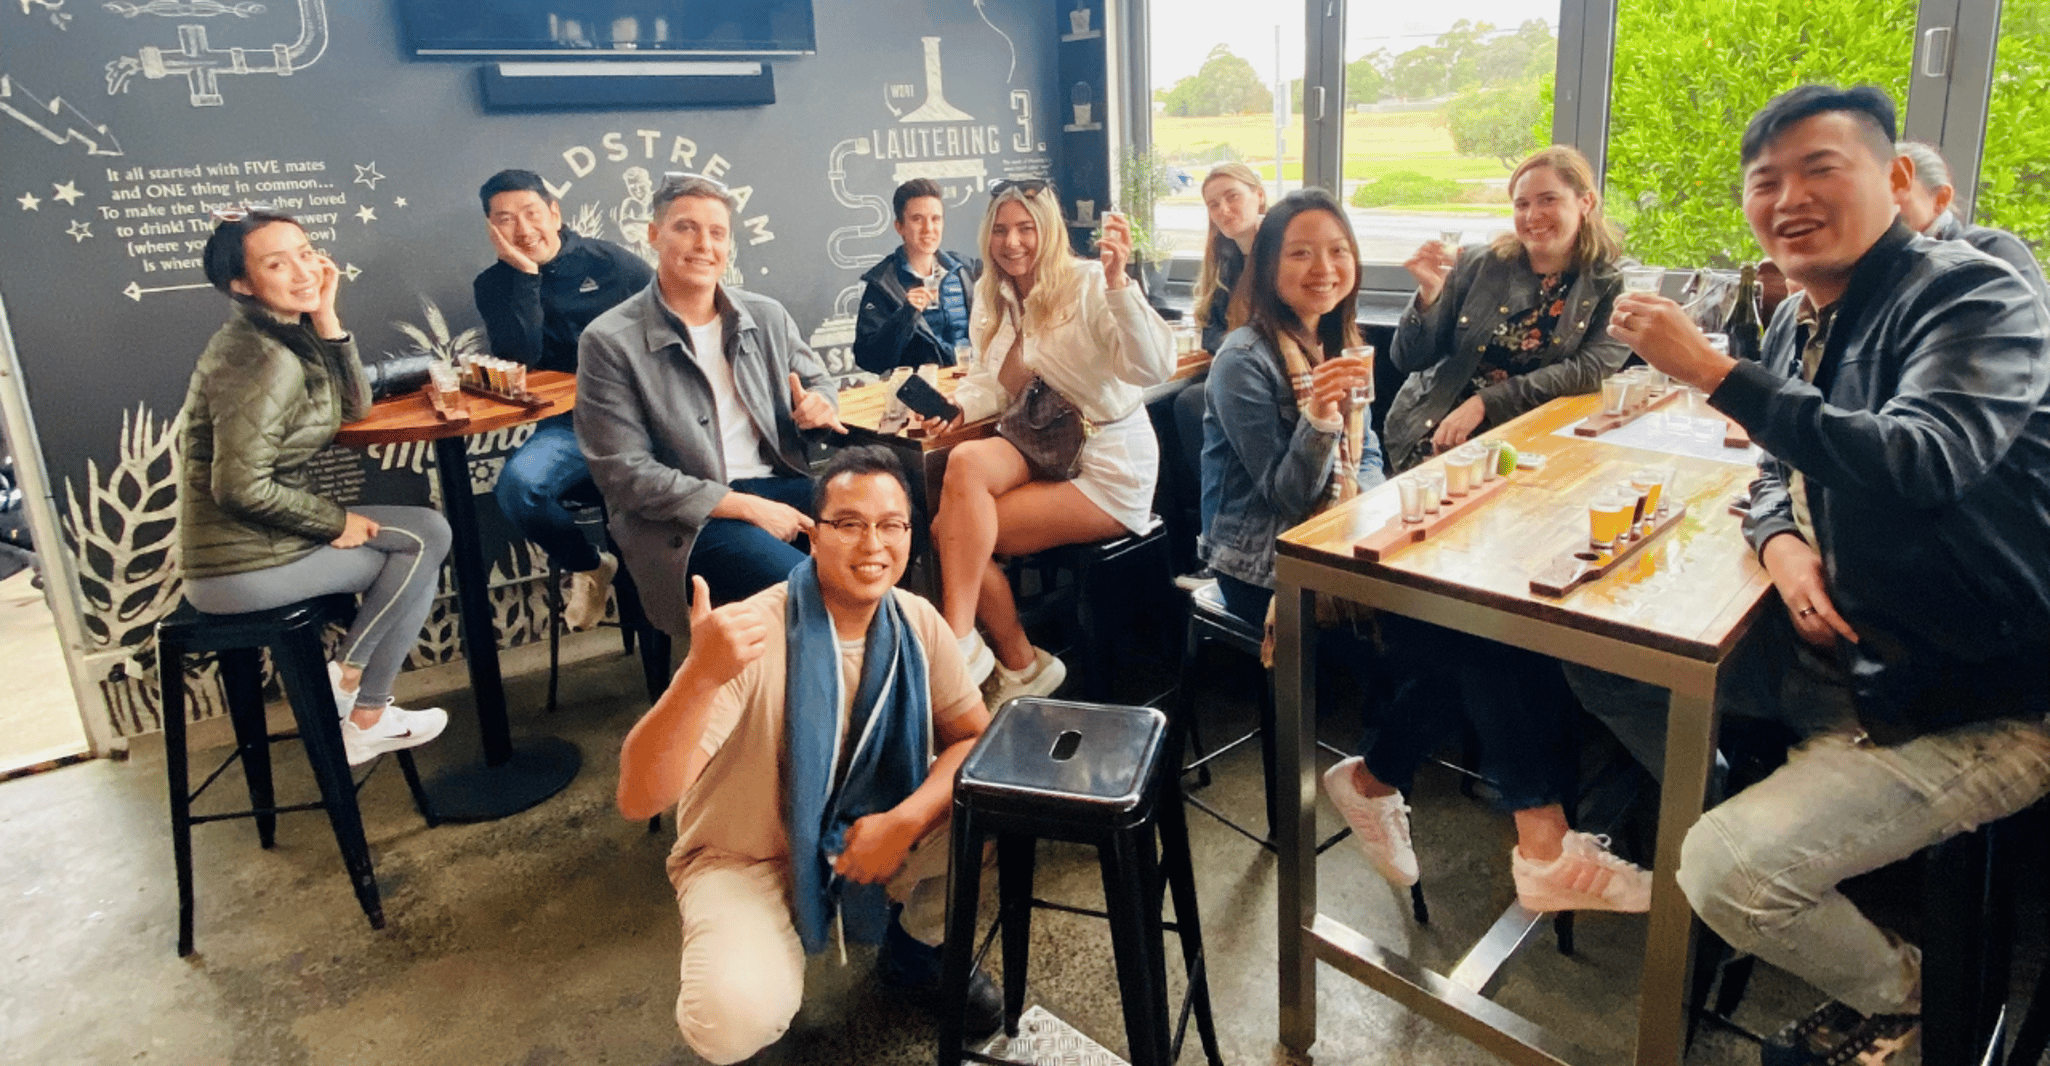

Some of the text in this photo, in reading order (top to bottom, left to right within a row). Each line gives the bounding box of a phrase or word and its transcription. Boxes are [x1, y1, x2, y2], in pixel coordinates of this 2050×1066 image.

[872, 125, 1000, 159] LAUTERING
[106, 160, 326, 182] It all started with FIVE mates
[111, 179, 334, 201] and ONE thing in common...
[541, 129, 775, 246] LDSTREAM
[98, 205, 120, 220] To
[124, 203, 166, 218] make
[170, 202, 196, 215] the
[308, 191, 347, 206] loved
[116, 226, 134, 237] to
[127, 240, 180, 257] (where
[142, 259, 156, 273] Is
